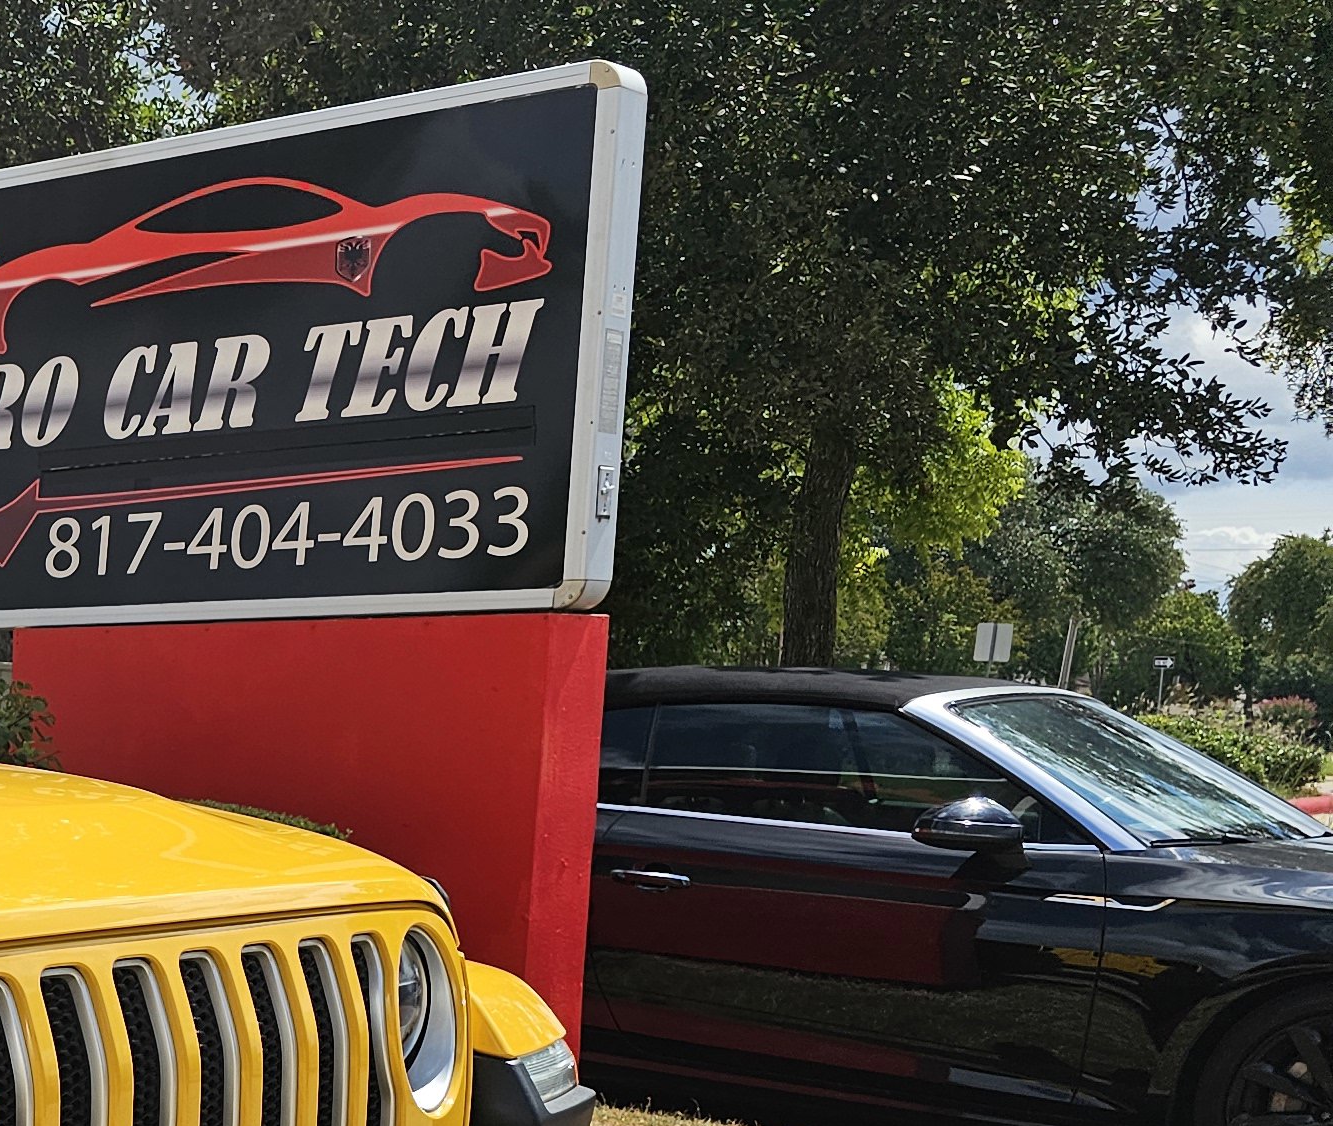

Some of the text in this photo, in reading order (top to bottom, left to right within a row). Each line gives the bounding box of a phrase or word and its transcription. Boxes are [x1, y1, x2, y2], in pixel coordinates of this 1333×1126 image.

[101, 333, 271, 437] CAR
[294, 297, 545, 424] TECH
[43, 484, 531, 580] 817-404-4033
